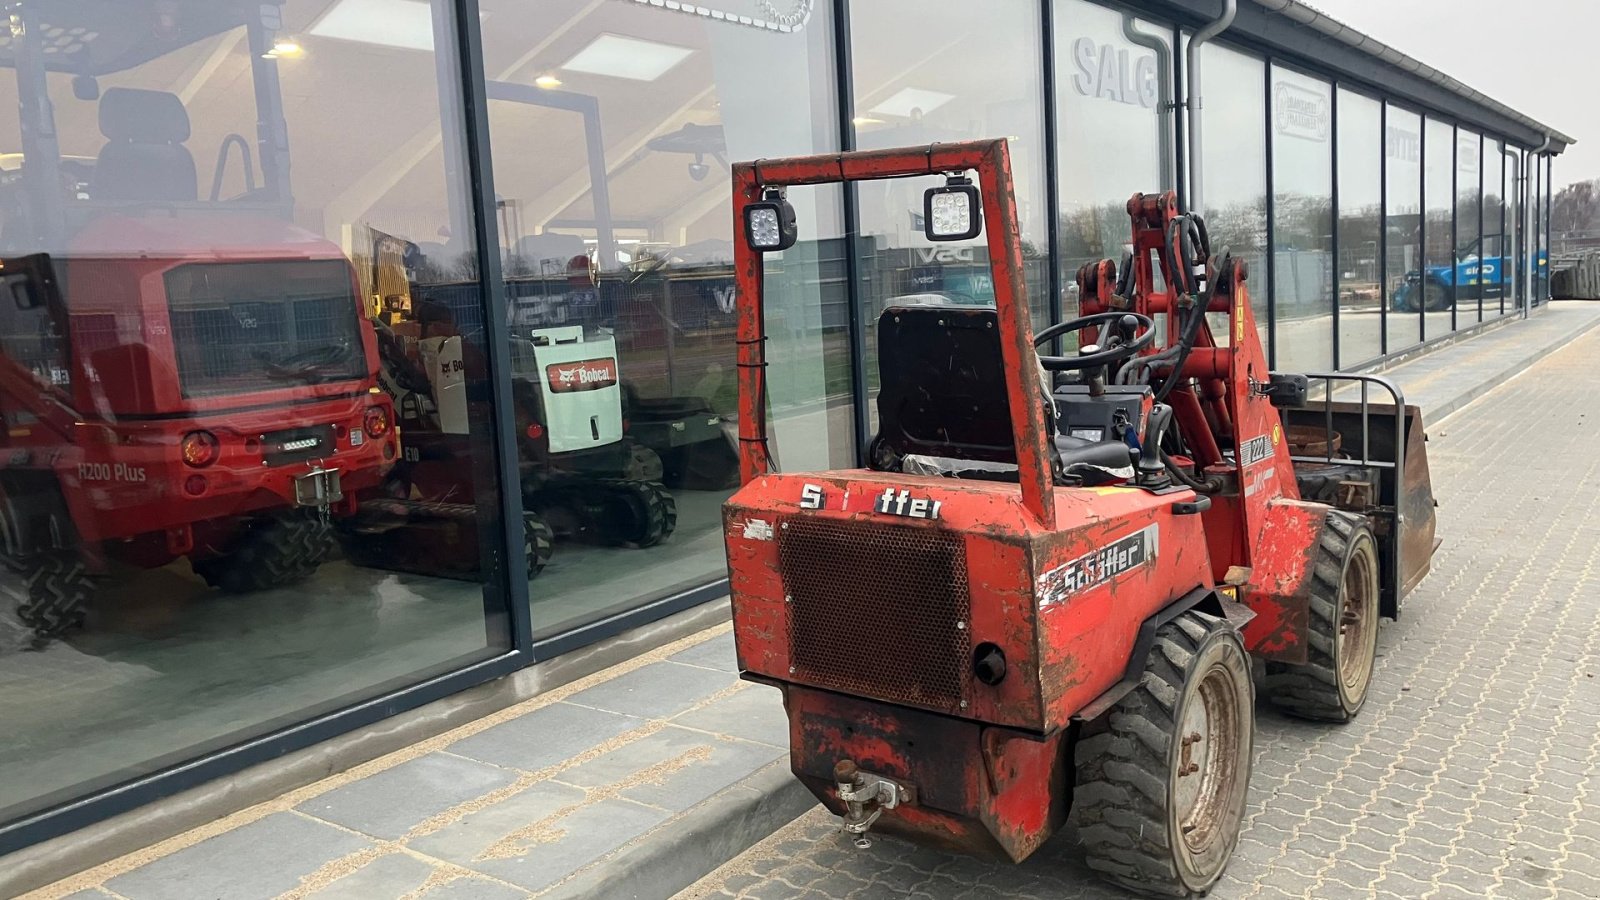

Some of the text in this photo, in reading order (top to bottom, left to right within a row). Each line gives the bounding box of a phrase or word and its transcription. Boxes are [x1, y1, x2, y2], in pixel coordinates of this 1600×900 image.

[579, 366, 610, 384] Bobcat
[405, 447, 419, 462] E10
[77, 463, 146, 481] H200 Plus
